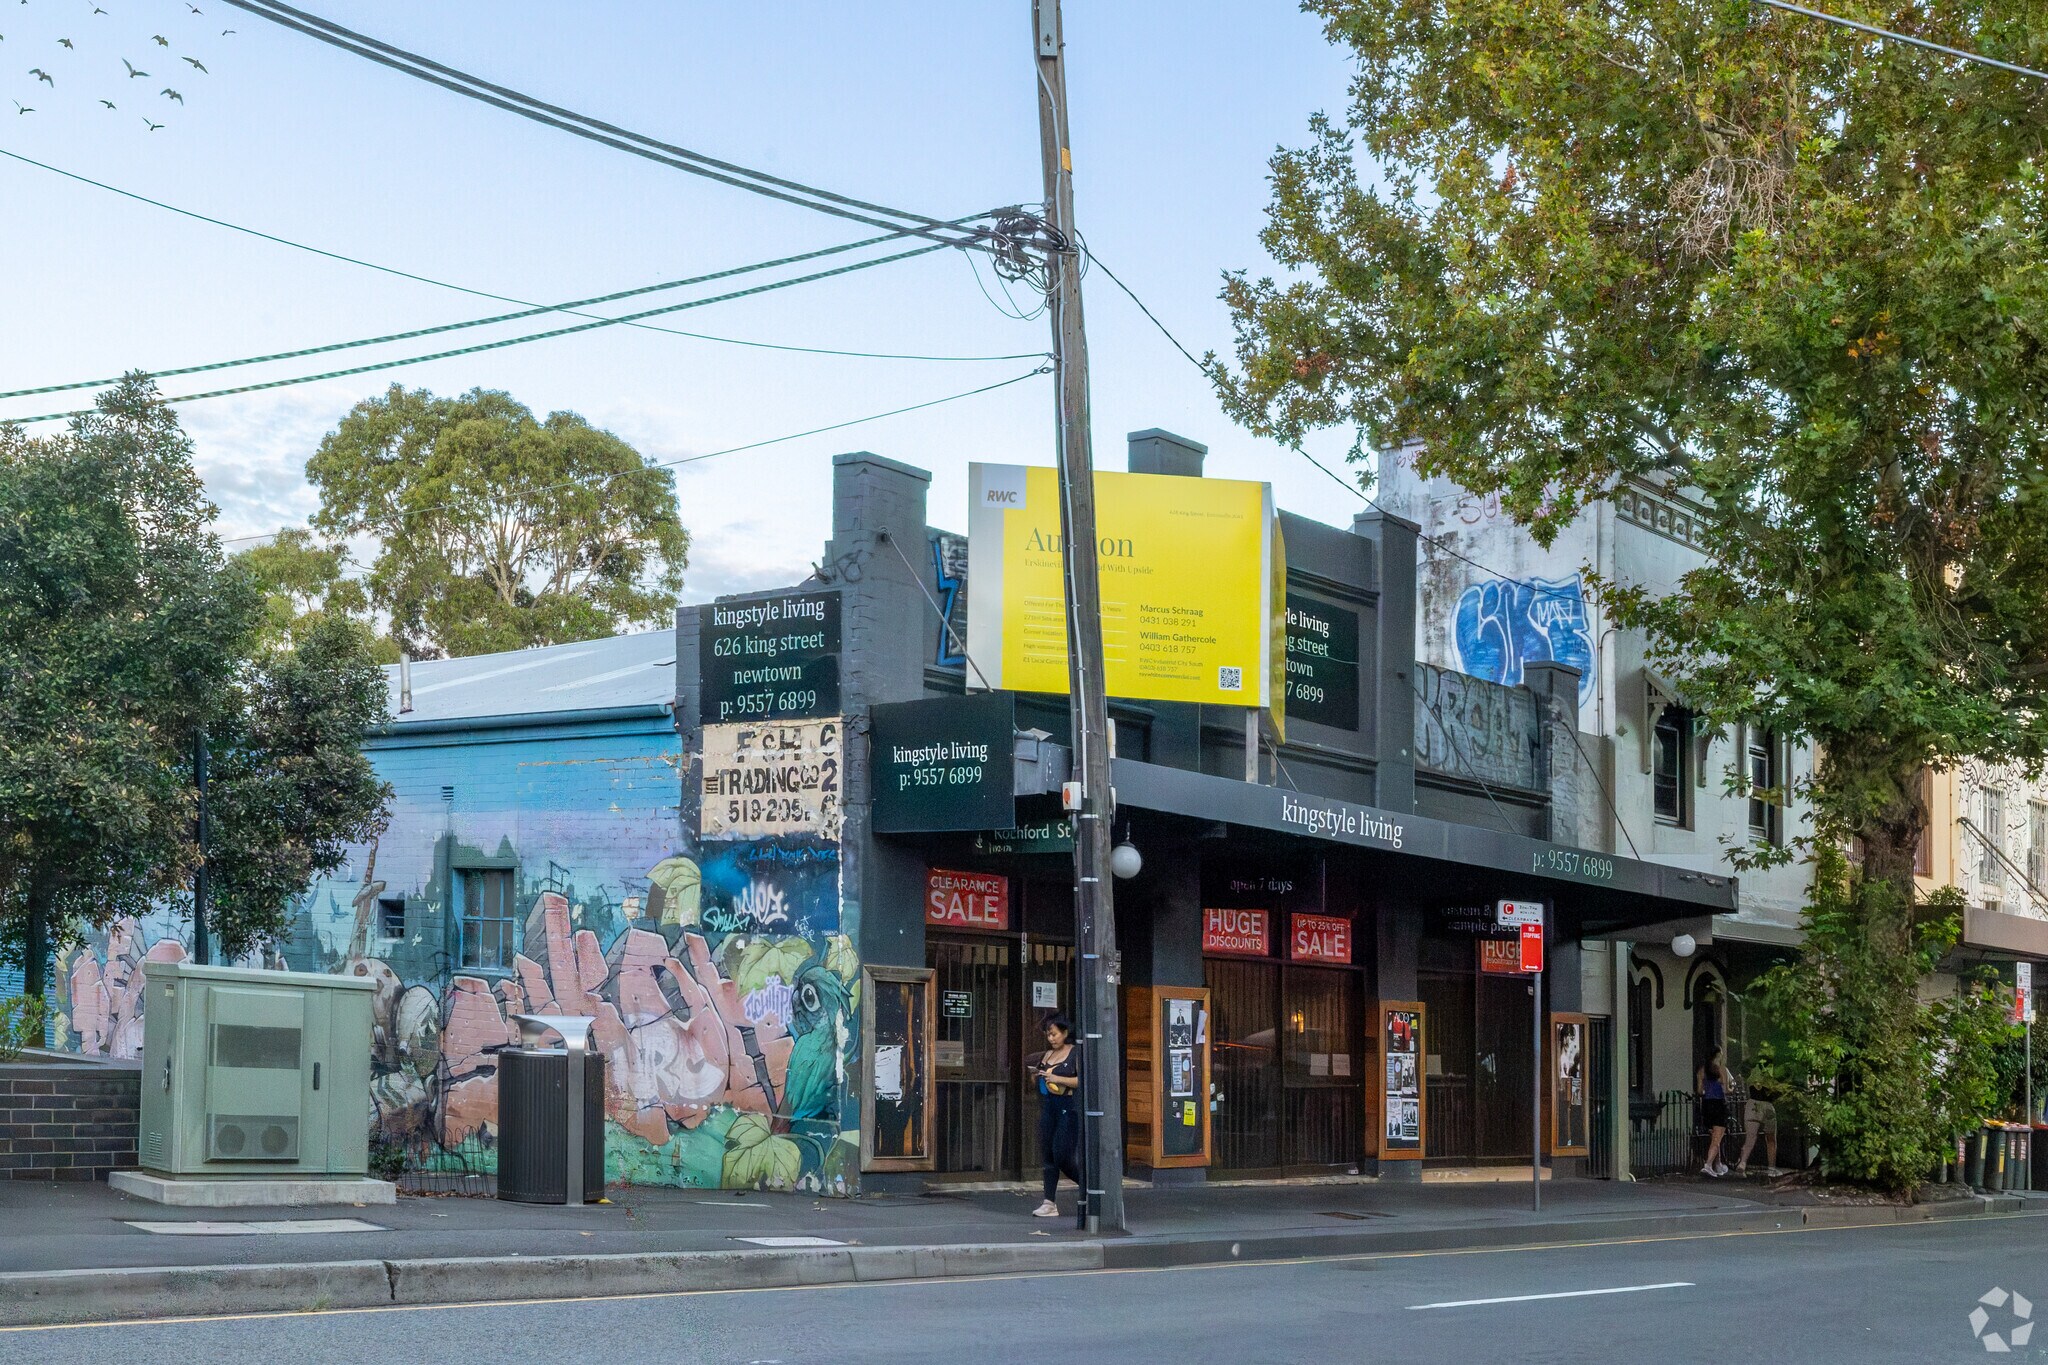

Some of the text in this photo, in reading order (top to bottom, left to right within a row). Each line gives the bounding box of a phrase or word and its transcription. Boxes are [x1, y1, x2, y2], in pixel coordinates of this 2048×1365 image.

[987, 490, 1017, 503] RWC
[1025, 527, 1134, 557] Auon
[1107, 563, 1126, 574] With
[1128, 564, 1154, 576] Upside
[714, 599, 825, 629] kingstyle living
[1140, 604, 1203, 618] Marcus Schraag
[1140, 616, 1196, 627] 0431 038 291
[1299, 611, 1329, 638] living
[714, 631, 825, 657] 626 king street
[1140, 631, 1217, 644] William Gathercole
[1297, 636, 1329, 657] street
[1140, 642, 1196, 654] 0403 618 757
[734, 665, 802, 685] newtown
[1296, 683, 1324, 703] 6899
[720, 690, 816, 720] p: 9557 6899
[893, 741, 988, 767] kingstyle living
[720, 766, 801, 796] TRADING
[900, 766, 982, 791] p: 9557 6899
[1057, 822, 1071, 839] St
[1282, 796, 1403, 849] kingstyle living
[1533, 850, 1613, 880] p: 9557 6899
[930, 876, 999, 894] CLEARANCE
[1268, 876, 1293, 894] days
[930, 890, 999, 923] SALE
[1505, 904, 1513, 914] C
[1209, 908, 1262, 935] HUGE
[1308, 919, 1317, 930] TO
[1332, 923, 1345, 934] OFF
[1210, 934, 1262, 950] DISCOUNTS
[1297, 930, 1345, 957] SALE
